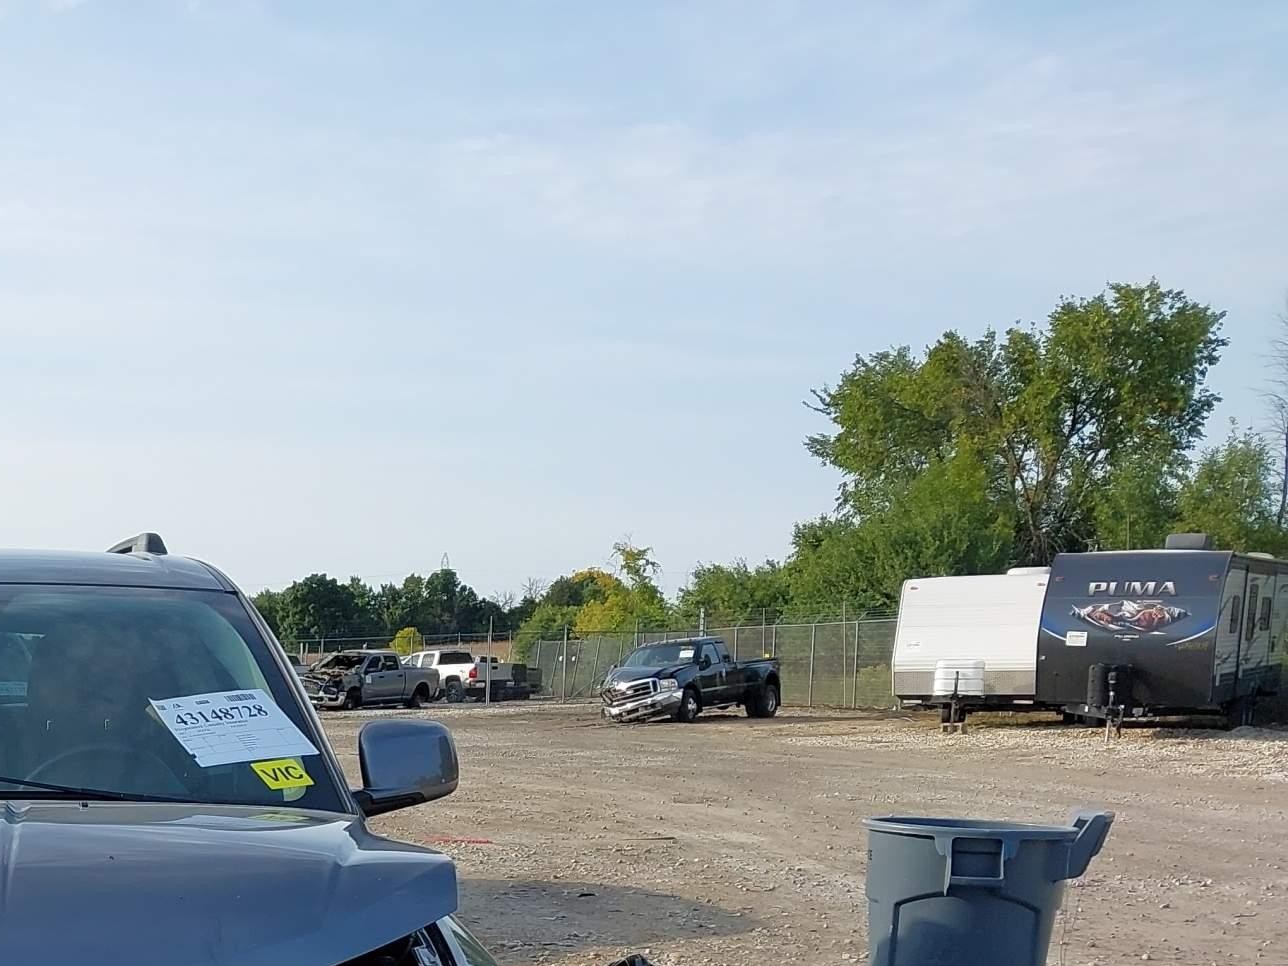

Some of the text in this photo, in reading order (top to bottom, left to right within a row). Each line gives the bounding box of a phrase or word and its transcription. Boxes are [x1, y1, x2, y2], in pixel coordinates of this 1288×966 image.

[1088, 581, 1177, 597] PUMA
[175, 704, 269, 726] 43148728
[259, 765, 304, 783] VIC
